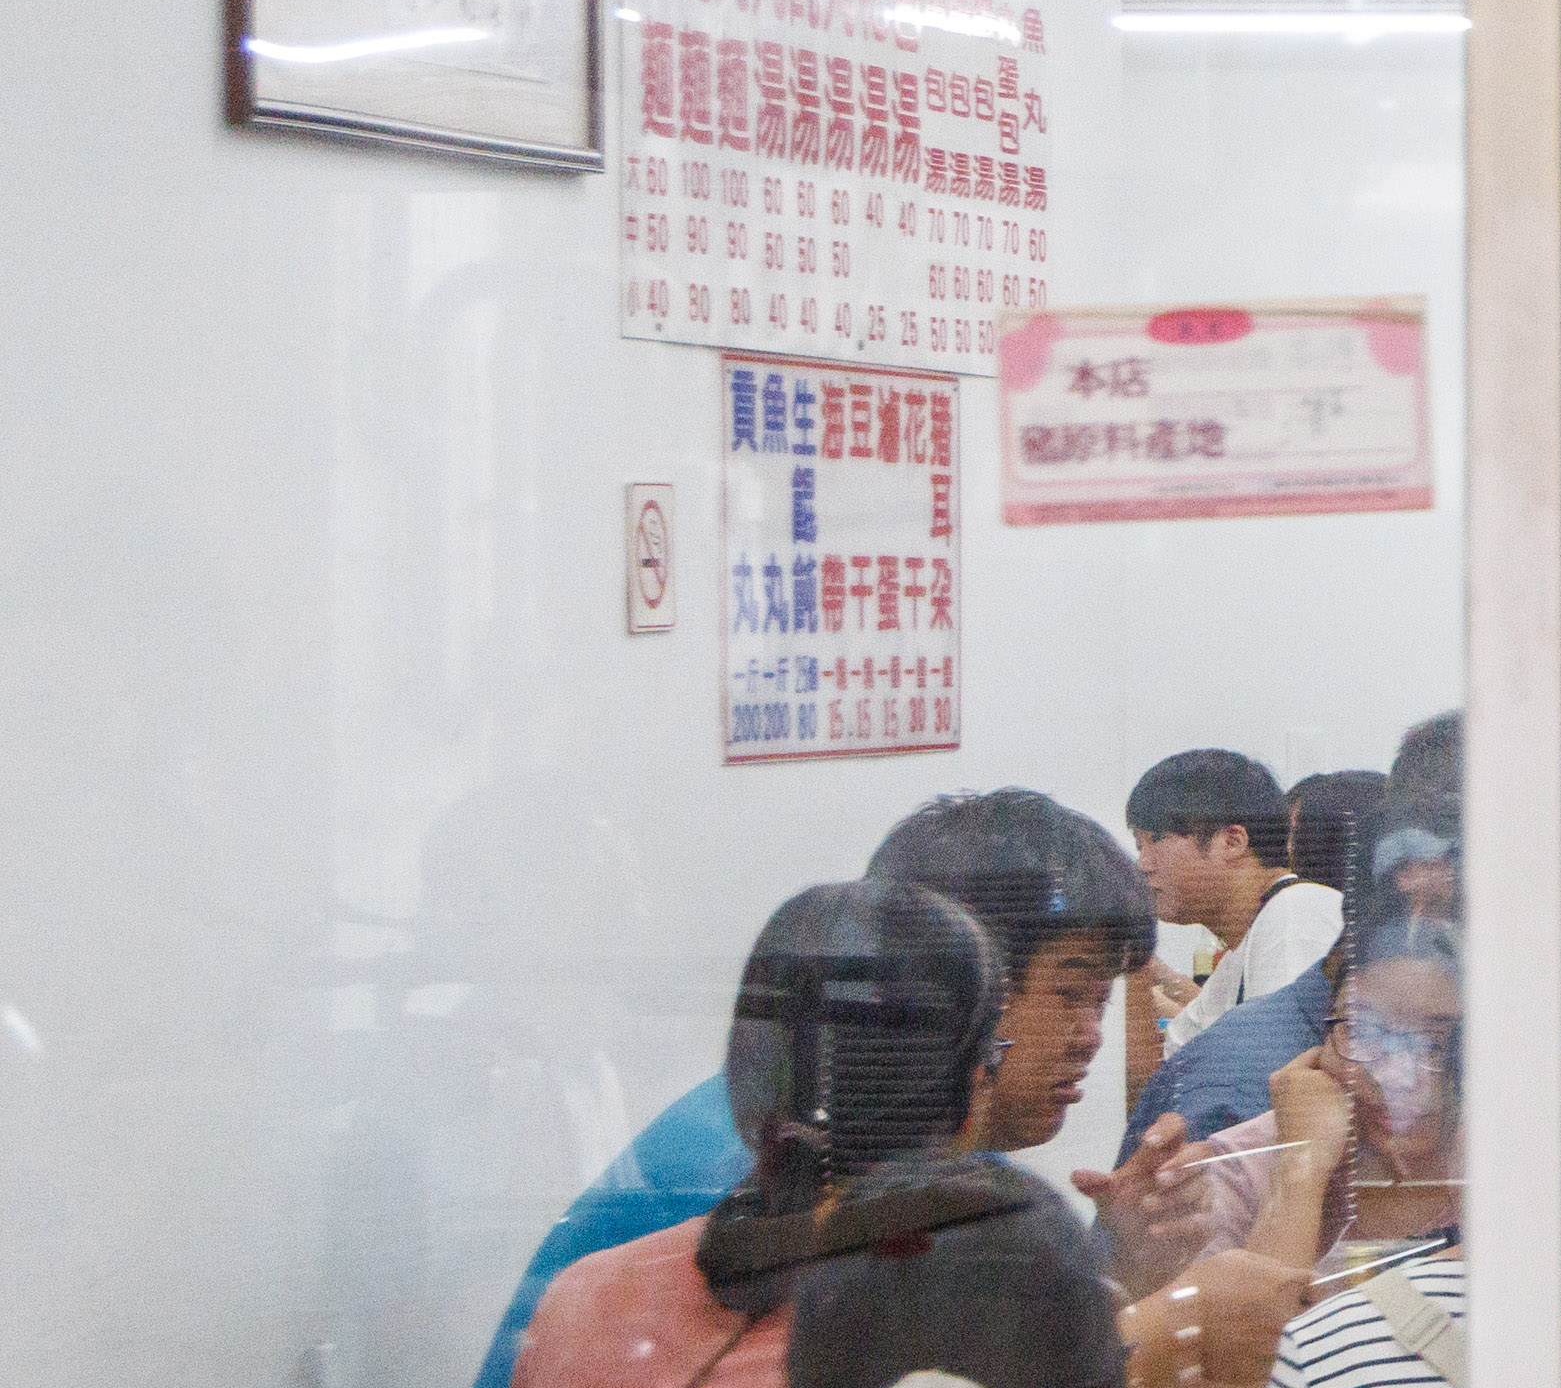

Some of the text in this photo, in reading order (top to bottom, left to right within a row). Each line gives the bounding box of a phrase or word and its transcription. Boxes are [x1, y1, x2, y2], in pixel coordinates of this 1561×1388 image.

[681, 160, 711, 201] 100
[720, 168, 750, 209] 100
[763, 175, 785, 216] 60
[796, 179, 817, 218] 60
[830, 188, 851, 226] 60
[866, 192, 885, 229] 40
[897, 200, 917, 237] 40
[927, 206, 945, 244] 70
[953, 211, 971, 248] 70
[976, 214, 994, 251] 70
[1001, 219, 1020, 255] 70
[1028, 227, 1047, 262] 60
[647, 212, 669, 253] 50
[764, 231, 785, 271] 50
[797, 235, 817, 274] 50
[831, 241, 851, 278] 50
[928, 263, 947, 301] 60
[954, 265, 971, 302] 60
[976, 268, 994, 303] 60
[1002, 273, 1021, 307] 60
[647, 278, 670, 318] 40
[768, 292, 788, 331] 40
[799, 296, 819, 334] 40
[834, 301, 852, 339] 40
[867, 303, 887, 342] 25
[899, 310, 919, 347] 25
[929, 315, 948, 352] 50
[954, 318, 972, 354] 50
[978, 319, 995, 355] 50
[1066, 355, 1153, 399] 本店
